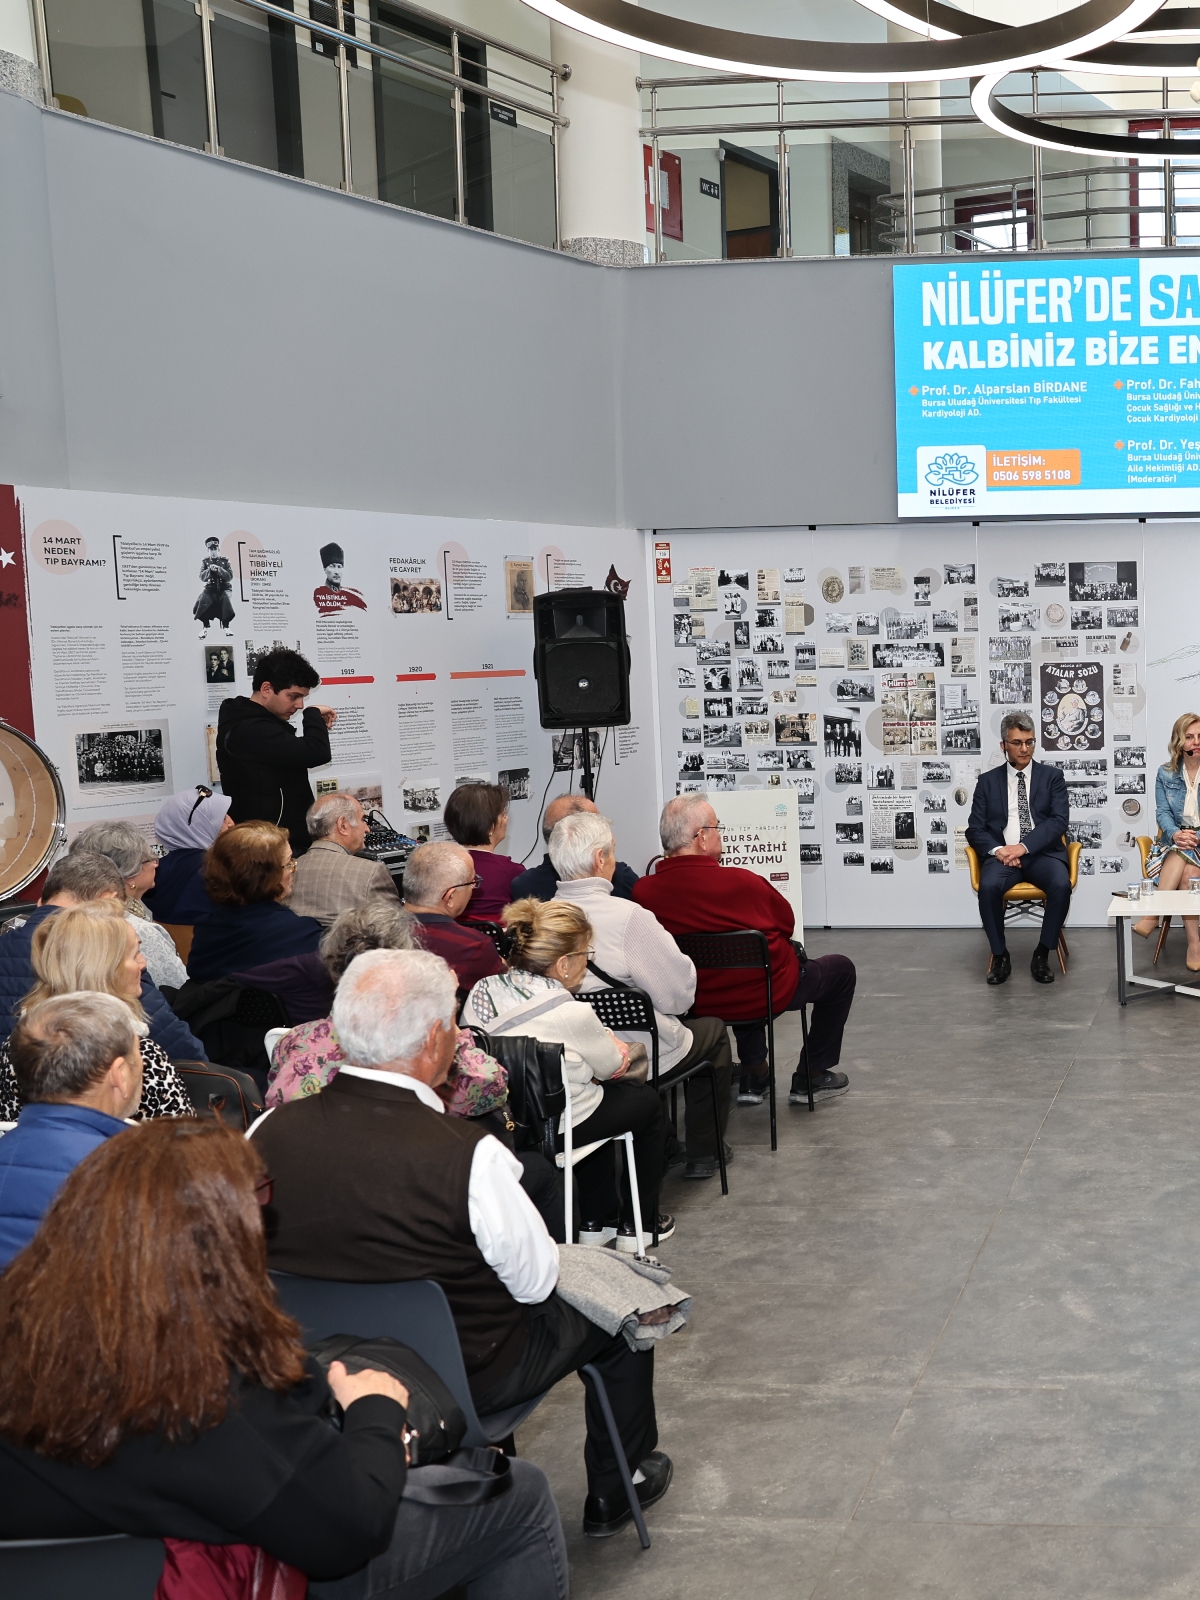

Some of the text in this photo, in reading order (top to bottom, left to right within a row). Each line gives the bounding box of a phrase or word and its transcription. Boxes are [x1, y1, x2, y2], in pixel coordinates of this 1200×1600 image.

[702, 182, 710, 192] WC
[923, 332, 1076, 370] KALBİNİZ
[1085, 330, 1159, 366] BİZE
[921, 381, 1088, 397] Prof. Dr. Alparslan BİRDANE
[1126, 378, 1155, 390] Prof.
[1159, 378, 1177, 389] Dr.
[921, 394, 1082, 408] Bursa Uludağ Üniversitesi Tıp Fakültesi
[1126, 392, 1151, 401] Bursa
[1152, 391, 1181, 402] Uludağ
[1126, 404, 1151, 413] Çocuk
[1153, 402, 1181, 413] Sağlığı
[921, 408, 982, 419] Kardiyoloji AD.
[1126, 415, 1151, 424] Çocuk
[1153, 413, 1198, 424] Kardiyoloji
[1127, 440, 1156, 451] Prof.
[1159, 439, 1177, 450] Dr.
[992, 454, 1046, 469] İLETİŞİM:
[1127, 453, 1151, 462] Bursa
[1153, 452, 1182, 462] Uludağ
[1127, 464, 1144, 472] Aile
[1146, 462, 1184, 473] Hekimliği
[1186, 463, 1200, 472] AD.
[993, 470, 1071, 482] 0506 598 5108
[1127, 474, 1177, 484] (Moderatör)
[929, 487, 976, 497] NİLÜFER
[929, 497, 975, 505] BELEDİYESİ
[43, 536, 81, 545] 14 MART
[44, 547, 76, 555] NEDEN
[45, 557, 107, 567] TIP BAYRAMI?
[249, 559, 283, 568] TIBBİYELİ
[250, 568, 277, 577] HİKMET
[1046, 665, 1099, 678] ATALAR SÖZÜ
[723, 834, 760, 843] BURSA
[744, 841, 788, 854] TARİHİ
